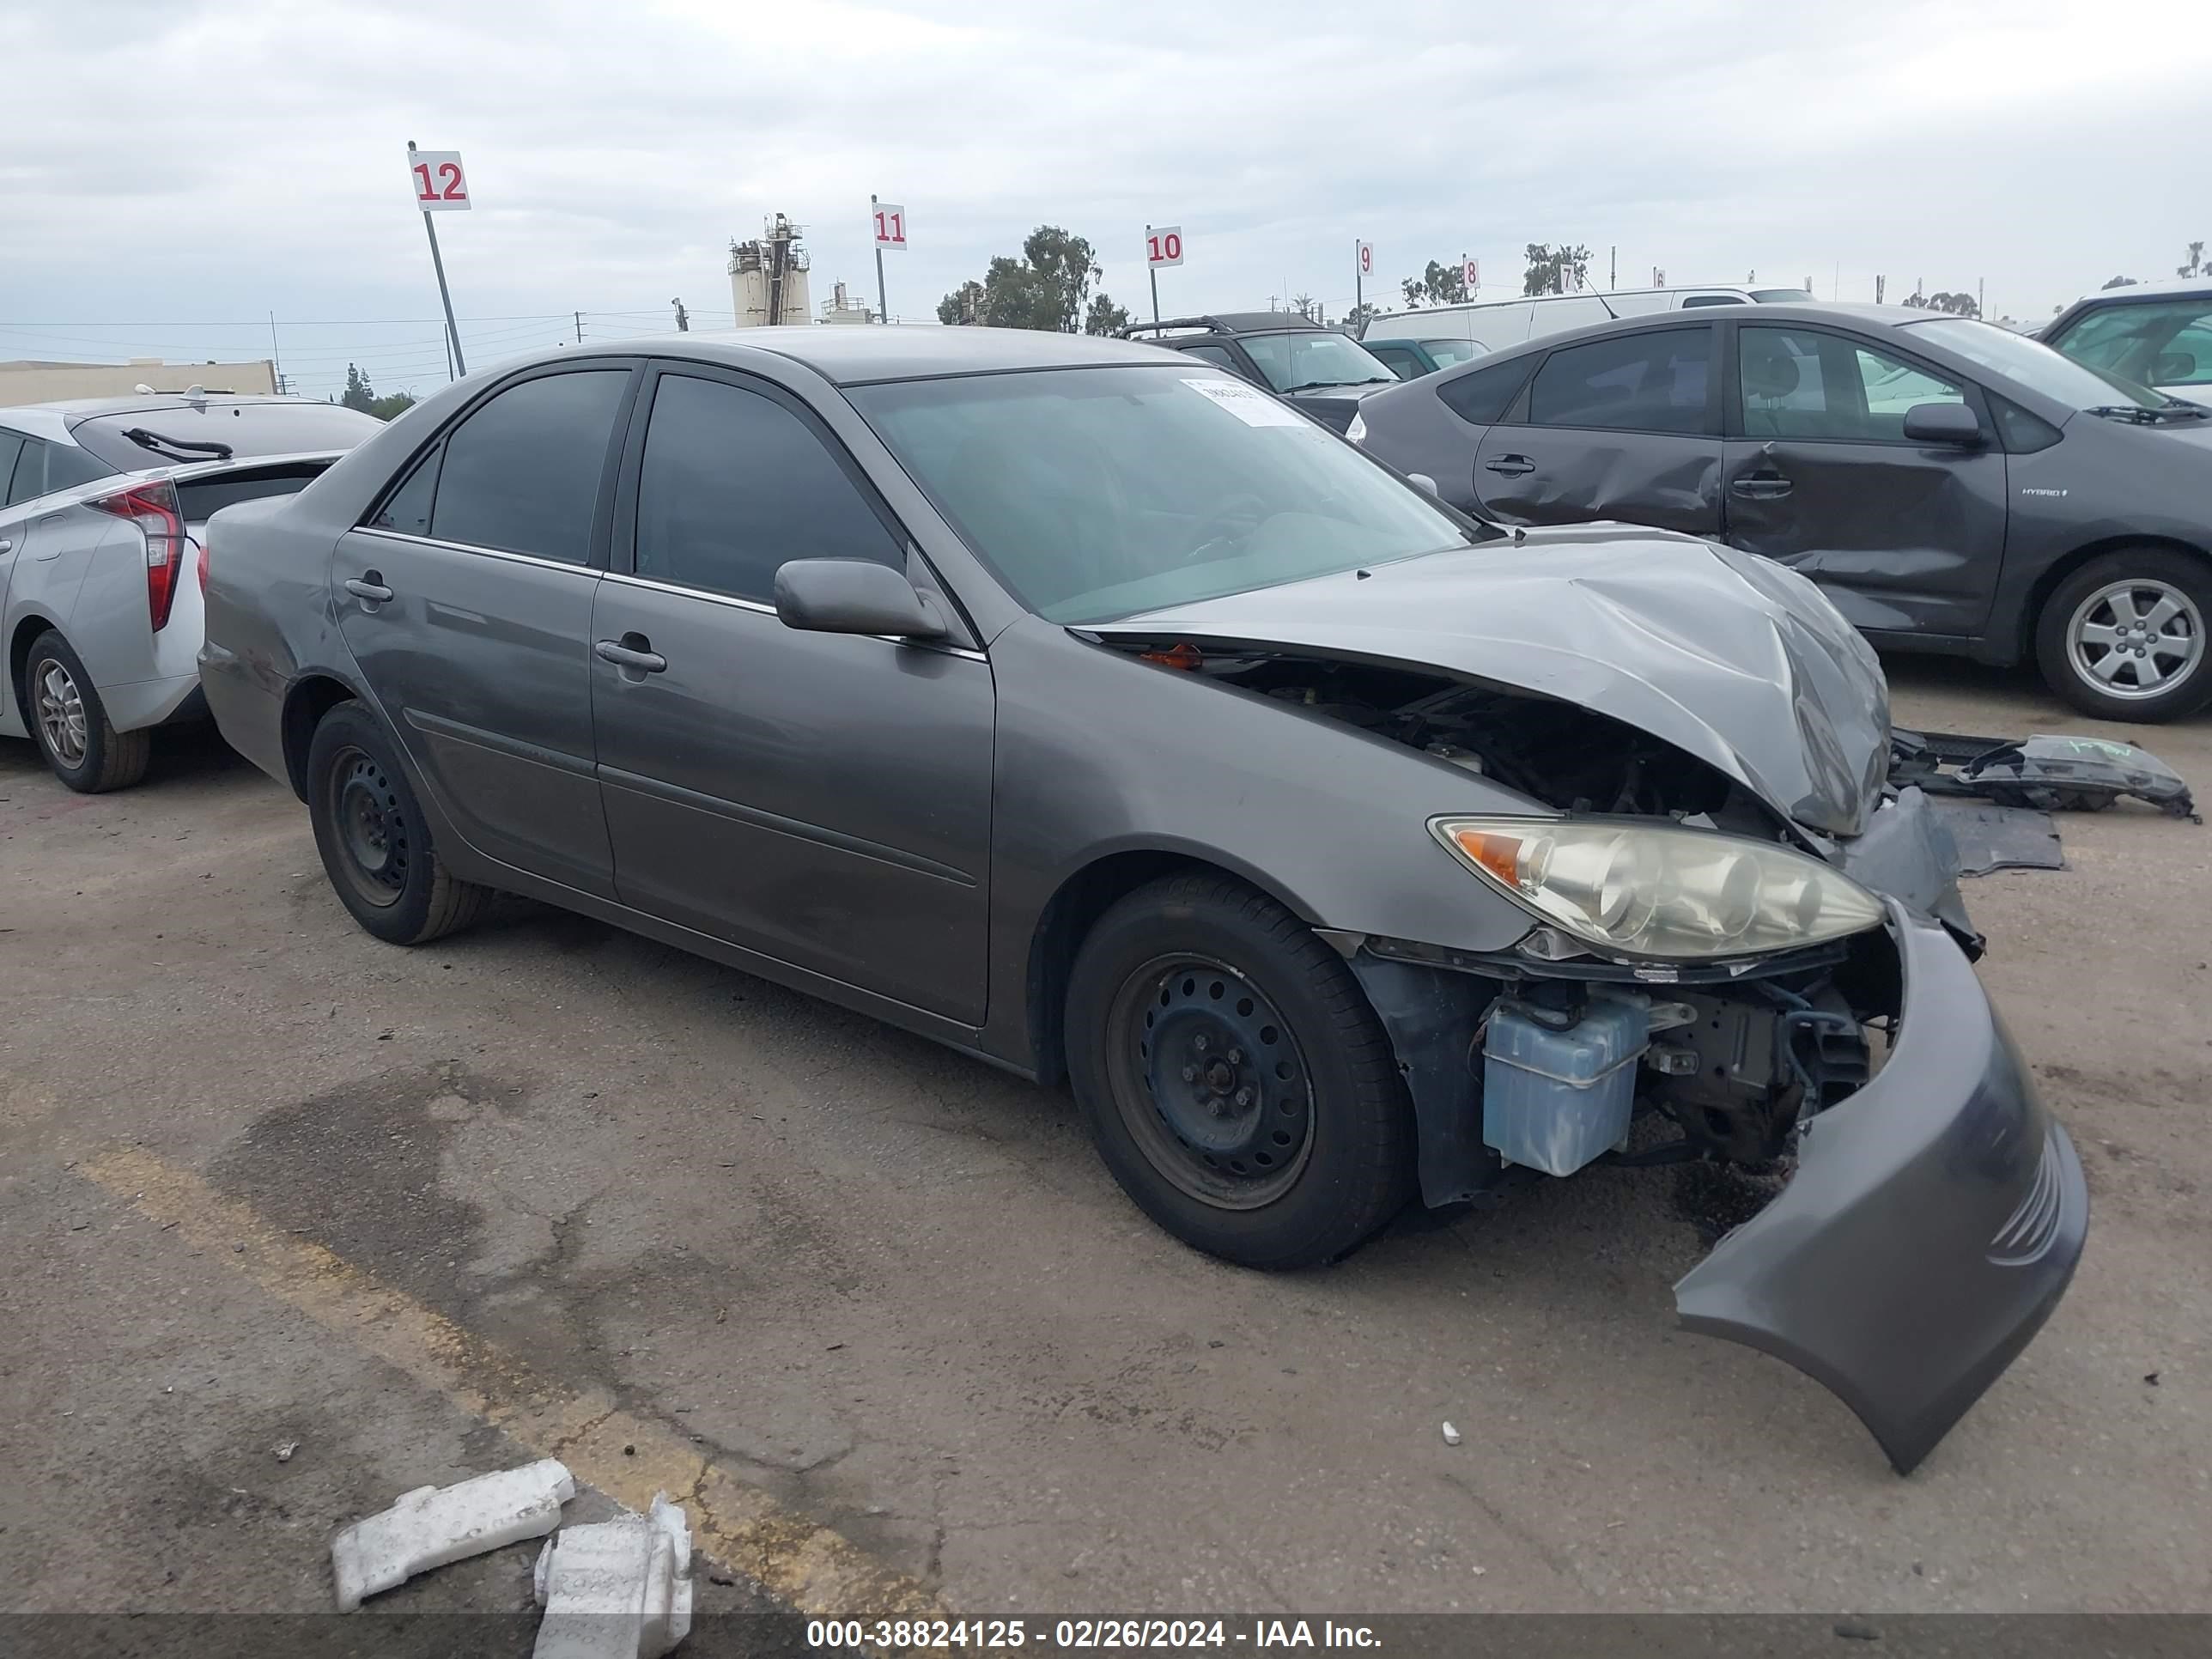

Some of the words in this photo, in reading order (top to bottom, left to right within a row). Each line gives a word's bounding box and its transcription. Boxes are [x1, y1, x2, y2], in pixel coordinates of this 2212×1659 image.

[414, 163, 466, 200] 12
[875, 211, 905, 242] 11
[1148, 234, 1181, 261] 10
[1361, 246, 1370, 272] 9
[1468, 261, 1476, 284] 8
[1563, 267, 1571, 288] 7
[1657, 272, 1664, 288] 6
[2021, 488, 2061, 497] HYBRID
